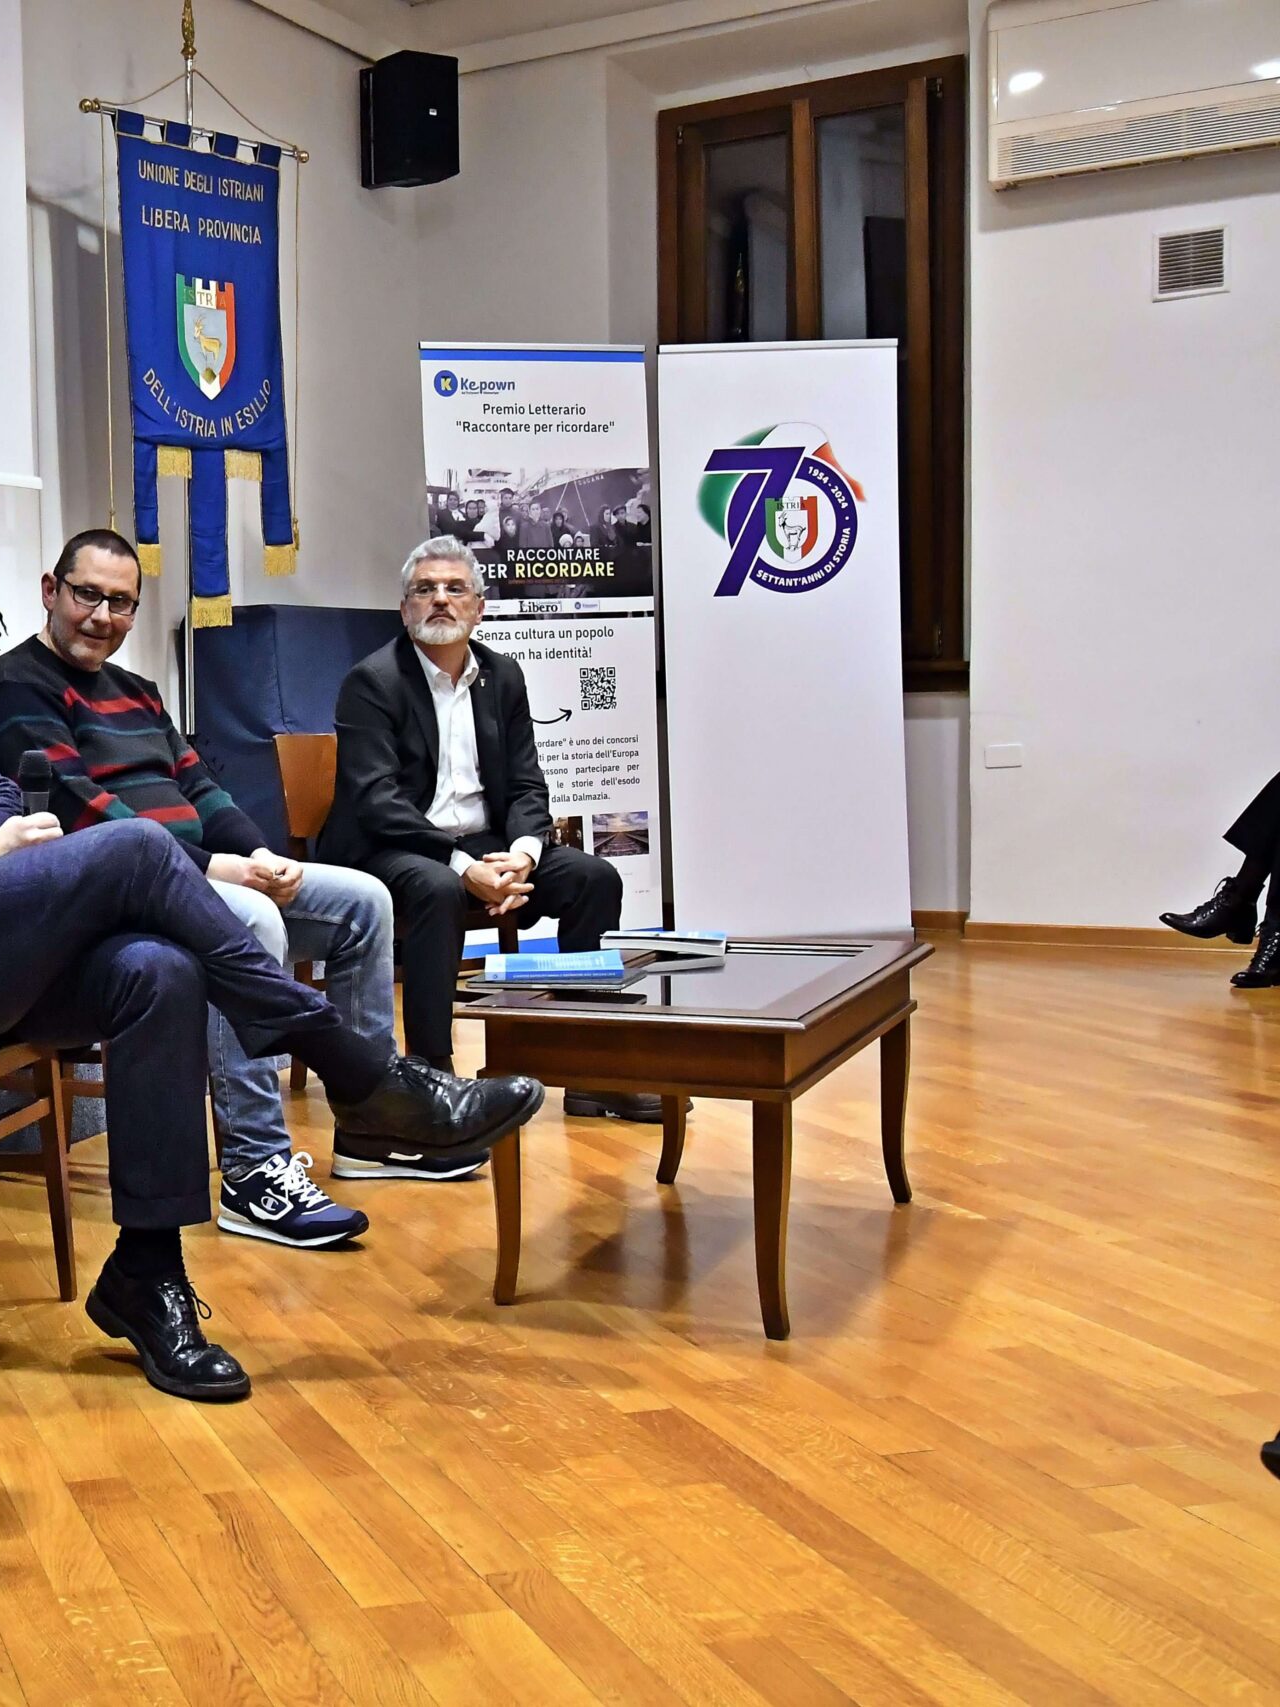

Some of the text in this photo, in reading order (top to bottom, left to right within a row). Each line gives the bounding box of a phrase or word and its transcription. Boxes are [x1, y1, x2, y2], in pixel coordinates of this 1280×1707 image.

[138, 159, 264, 202] UNIONE DEGLI ISTRIANI
[141, 204, 262, 244] LIBERA PROVINCIA
[221, 416, 234, 436] IN
[235, 379, 271, 431] ESILIO
[482, 403, 586, 416] Premio Letterario
[456, 420, 615, 435] "Raccontare per ricordare"
[808, 466, 829, 484] 1954
[831, 486, 848, 509] 2024
[776, 501, 805, 511] ISTRIA
[506, 548, 600, 562] RACCONTARE
[756, 527, 851, 587] SETTANT'ANNI DI STORIA
[515, 562, 615, 578] RICORDARE
[518, 600, 559, 613] Libero
[476, 626, 614, 641] Senza cultura un popolo
[528, 648, 542, 660] ha
[545, 646, 592, 659] identità!
[575, 738, 591, 746] uno
[592, 736, 605, 745] dei
[606, 734, 639, 744] concorsi
[546, 754, 560, 763] per
[561, 752, 569, 760] la
[571, 751, 594, 760] storia
[595, 749, 639, 759] dell'Europa
[541, 764, 640, 775] ossono partecipare per
[556, 780, 564, 788] le
[571, 779, 594, 788] storie
[600, 776, 641, 787] dell'esodo
[551, 792, 611, 803] dalla Dalmazia.
